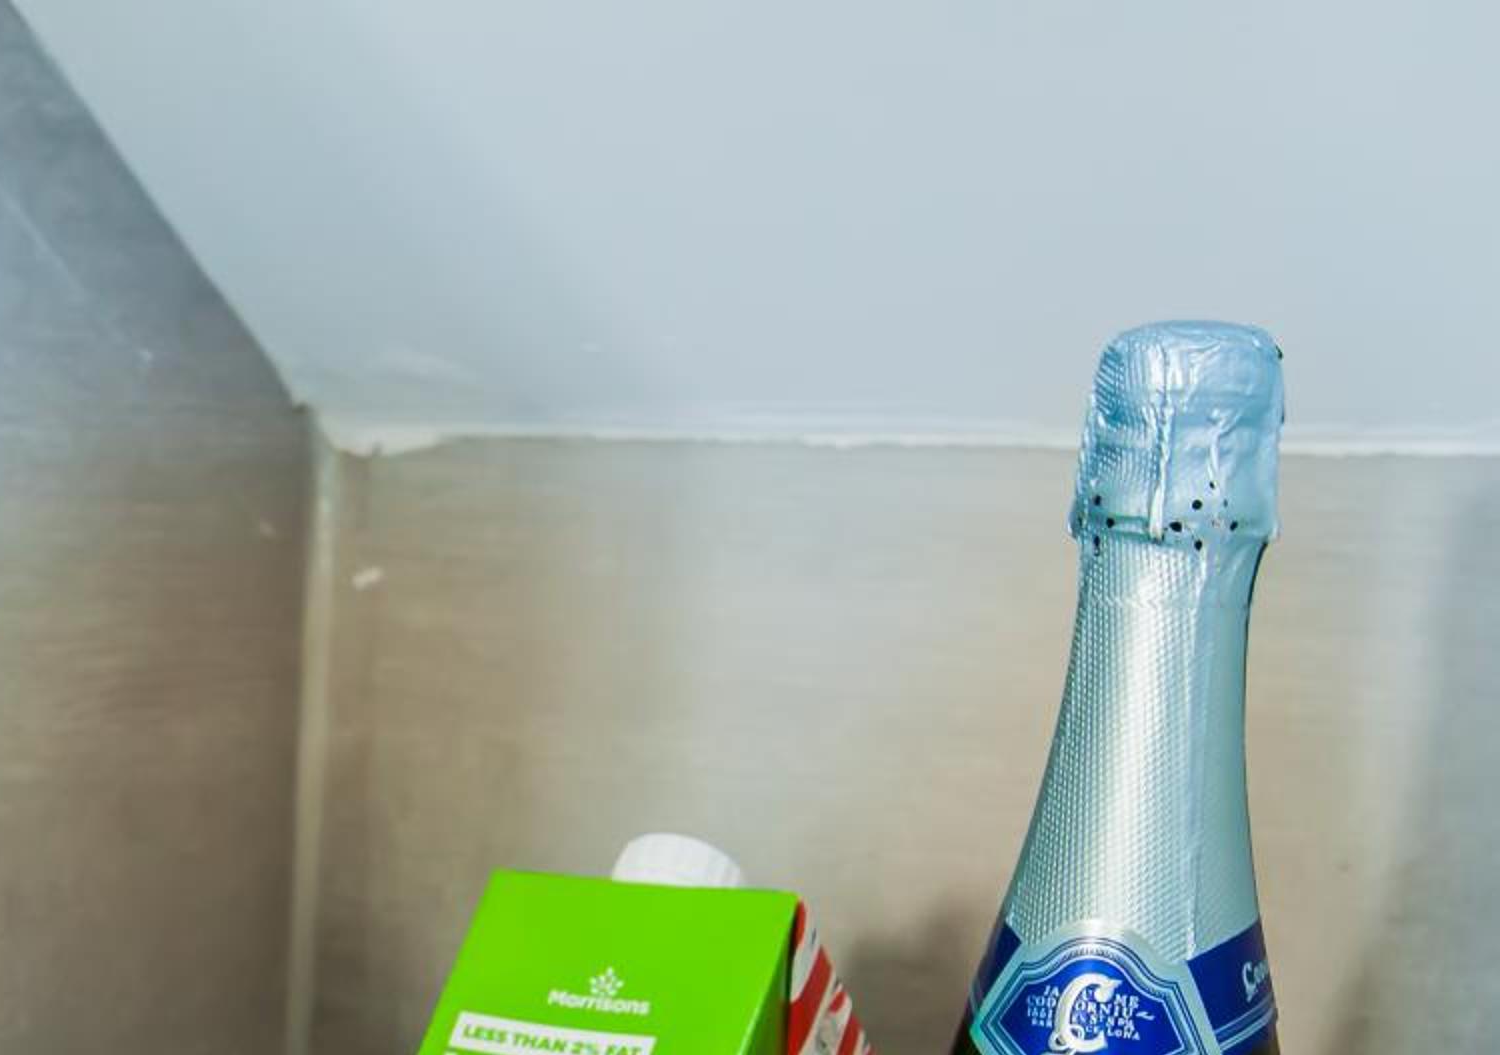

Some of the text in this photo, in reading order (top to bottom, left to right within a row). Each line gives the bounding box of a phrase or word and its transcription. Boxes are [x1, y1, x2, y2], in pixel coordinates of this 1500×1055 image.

[547, 989, 650, 1015] Morrisons
[461, 1023, 508, 1046] LESS
[511, 1031, 567, 1055] THAN
